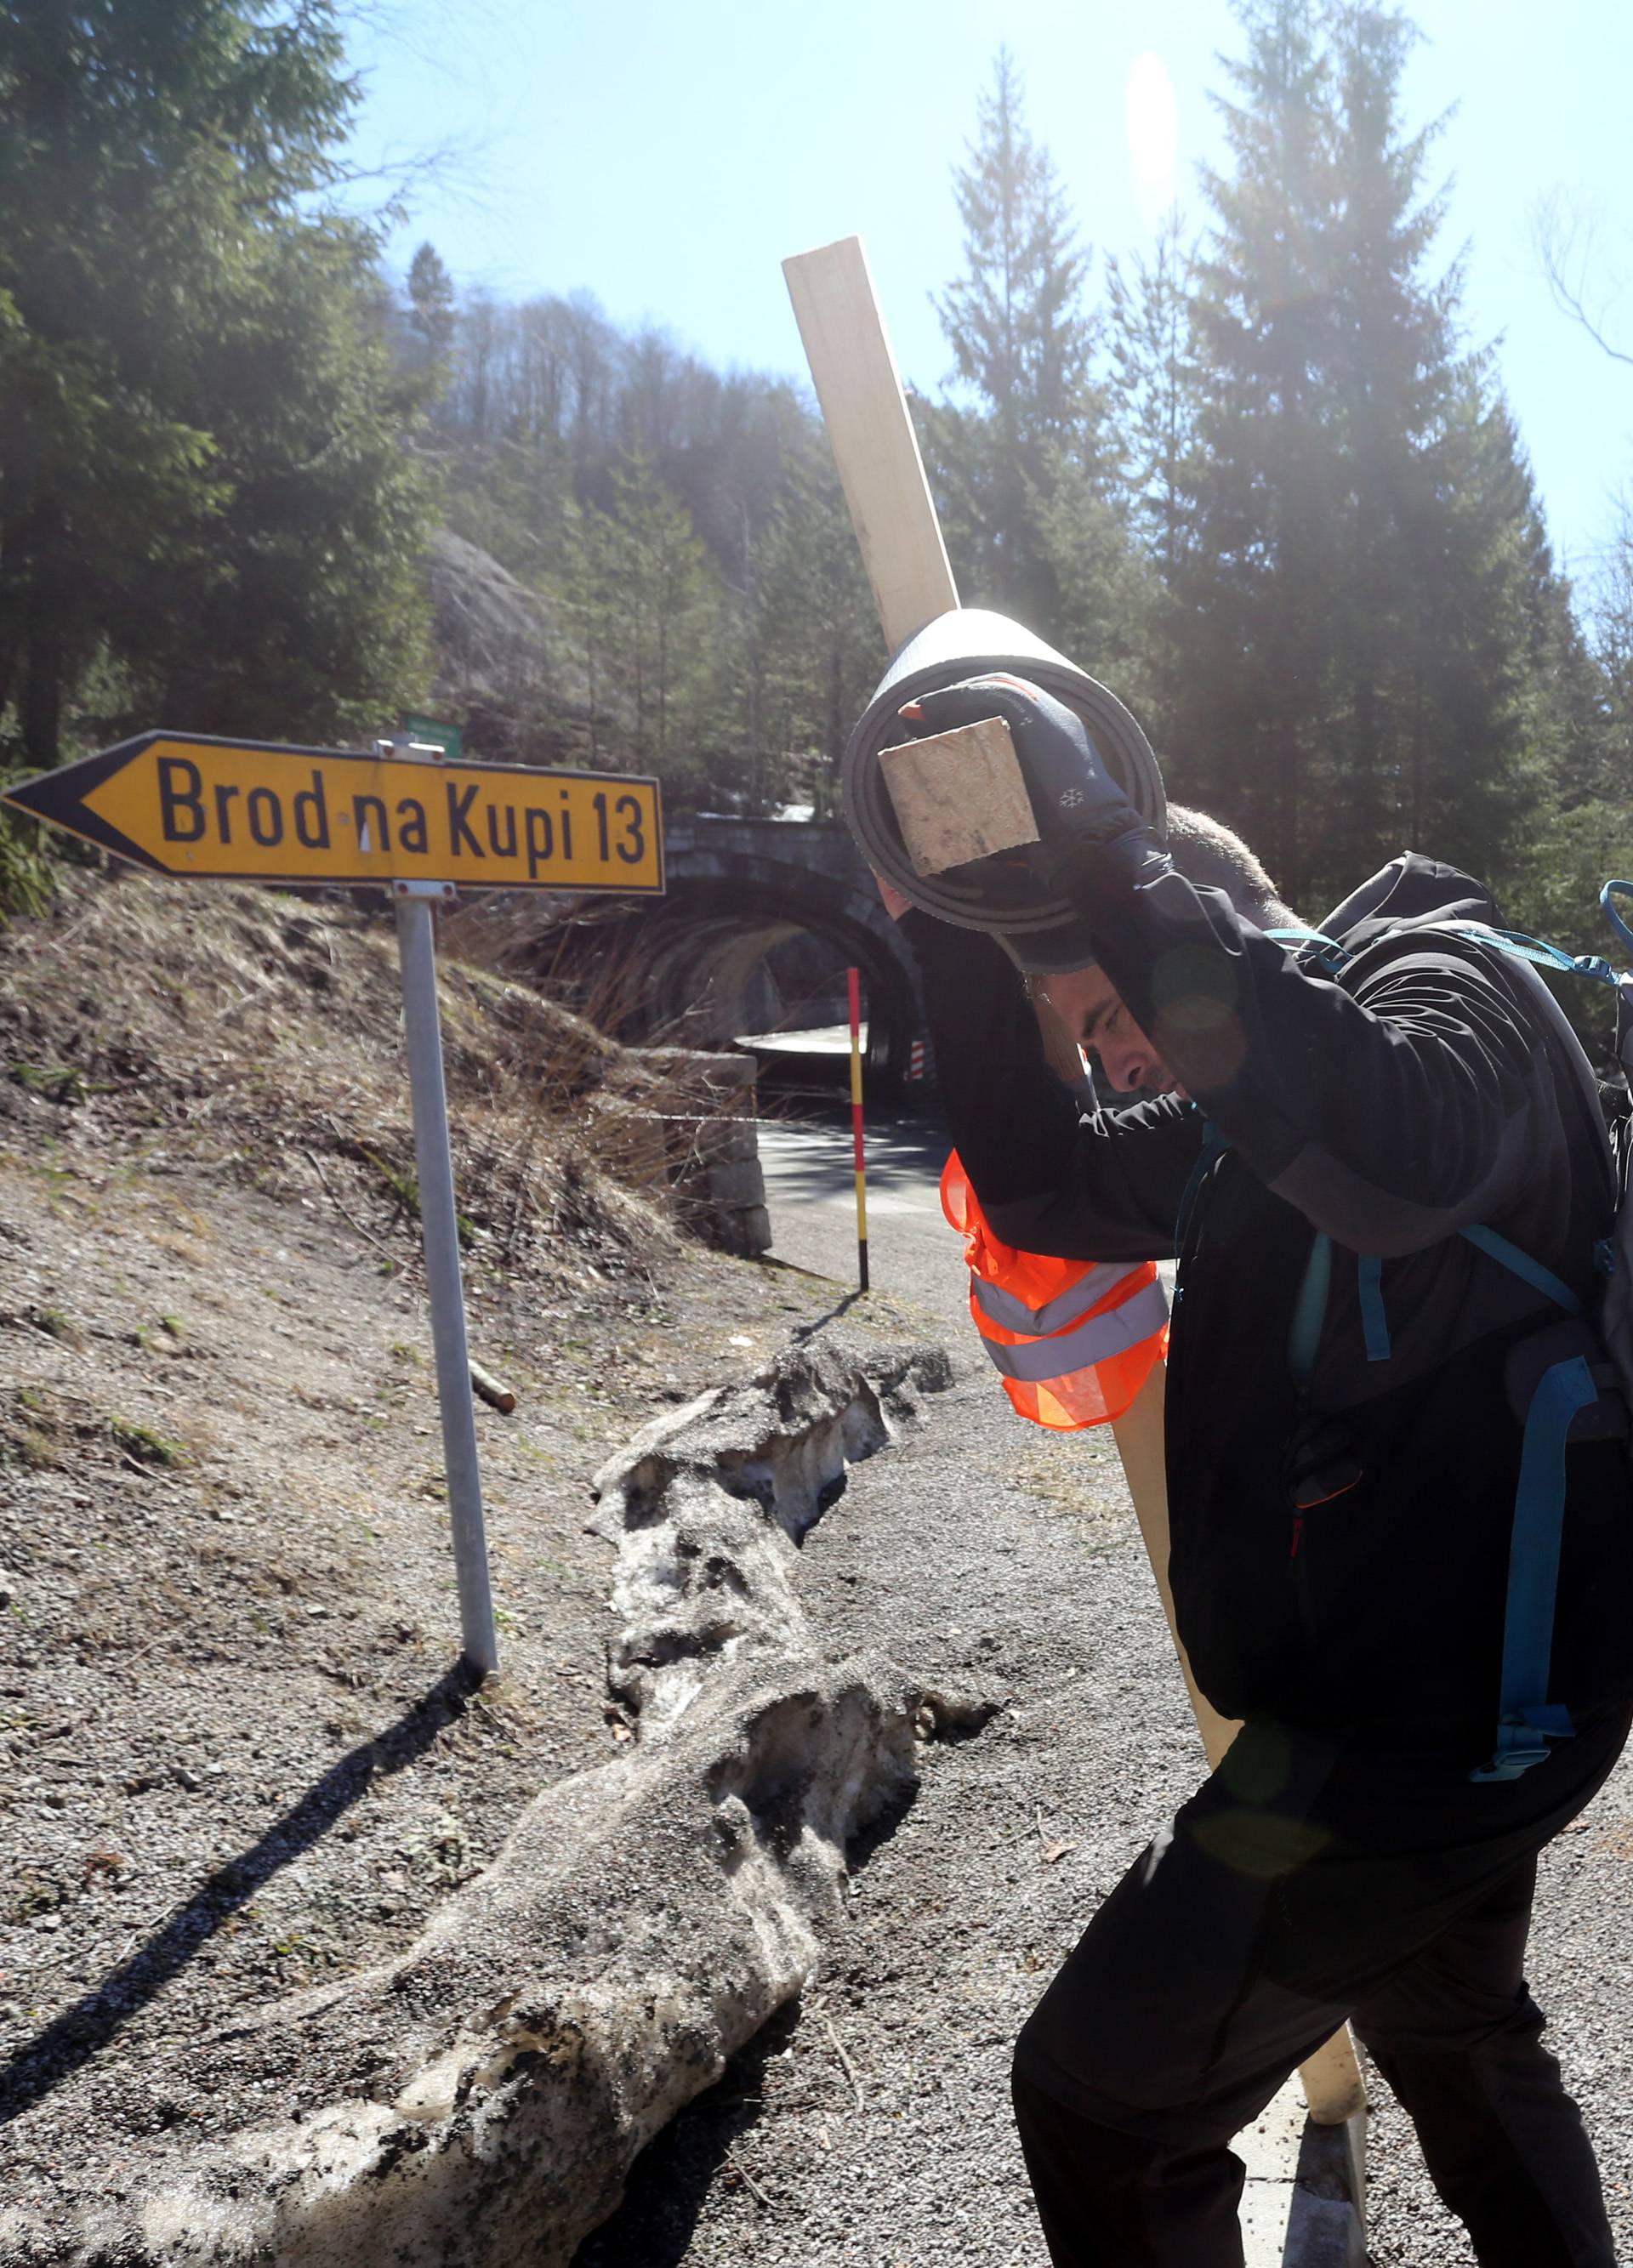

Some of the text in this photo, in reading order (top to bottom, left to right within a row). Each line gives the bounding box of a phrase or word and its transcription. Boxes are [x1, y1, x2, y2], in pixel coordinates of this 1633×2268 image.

[157, 756, 645, 880] Brod na Kupi 13
